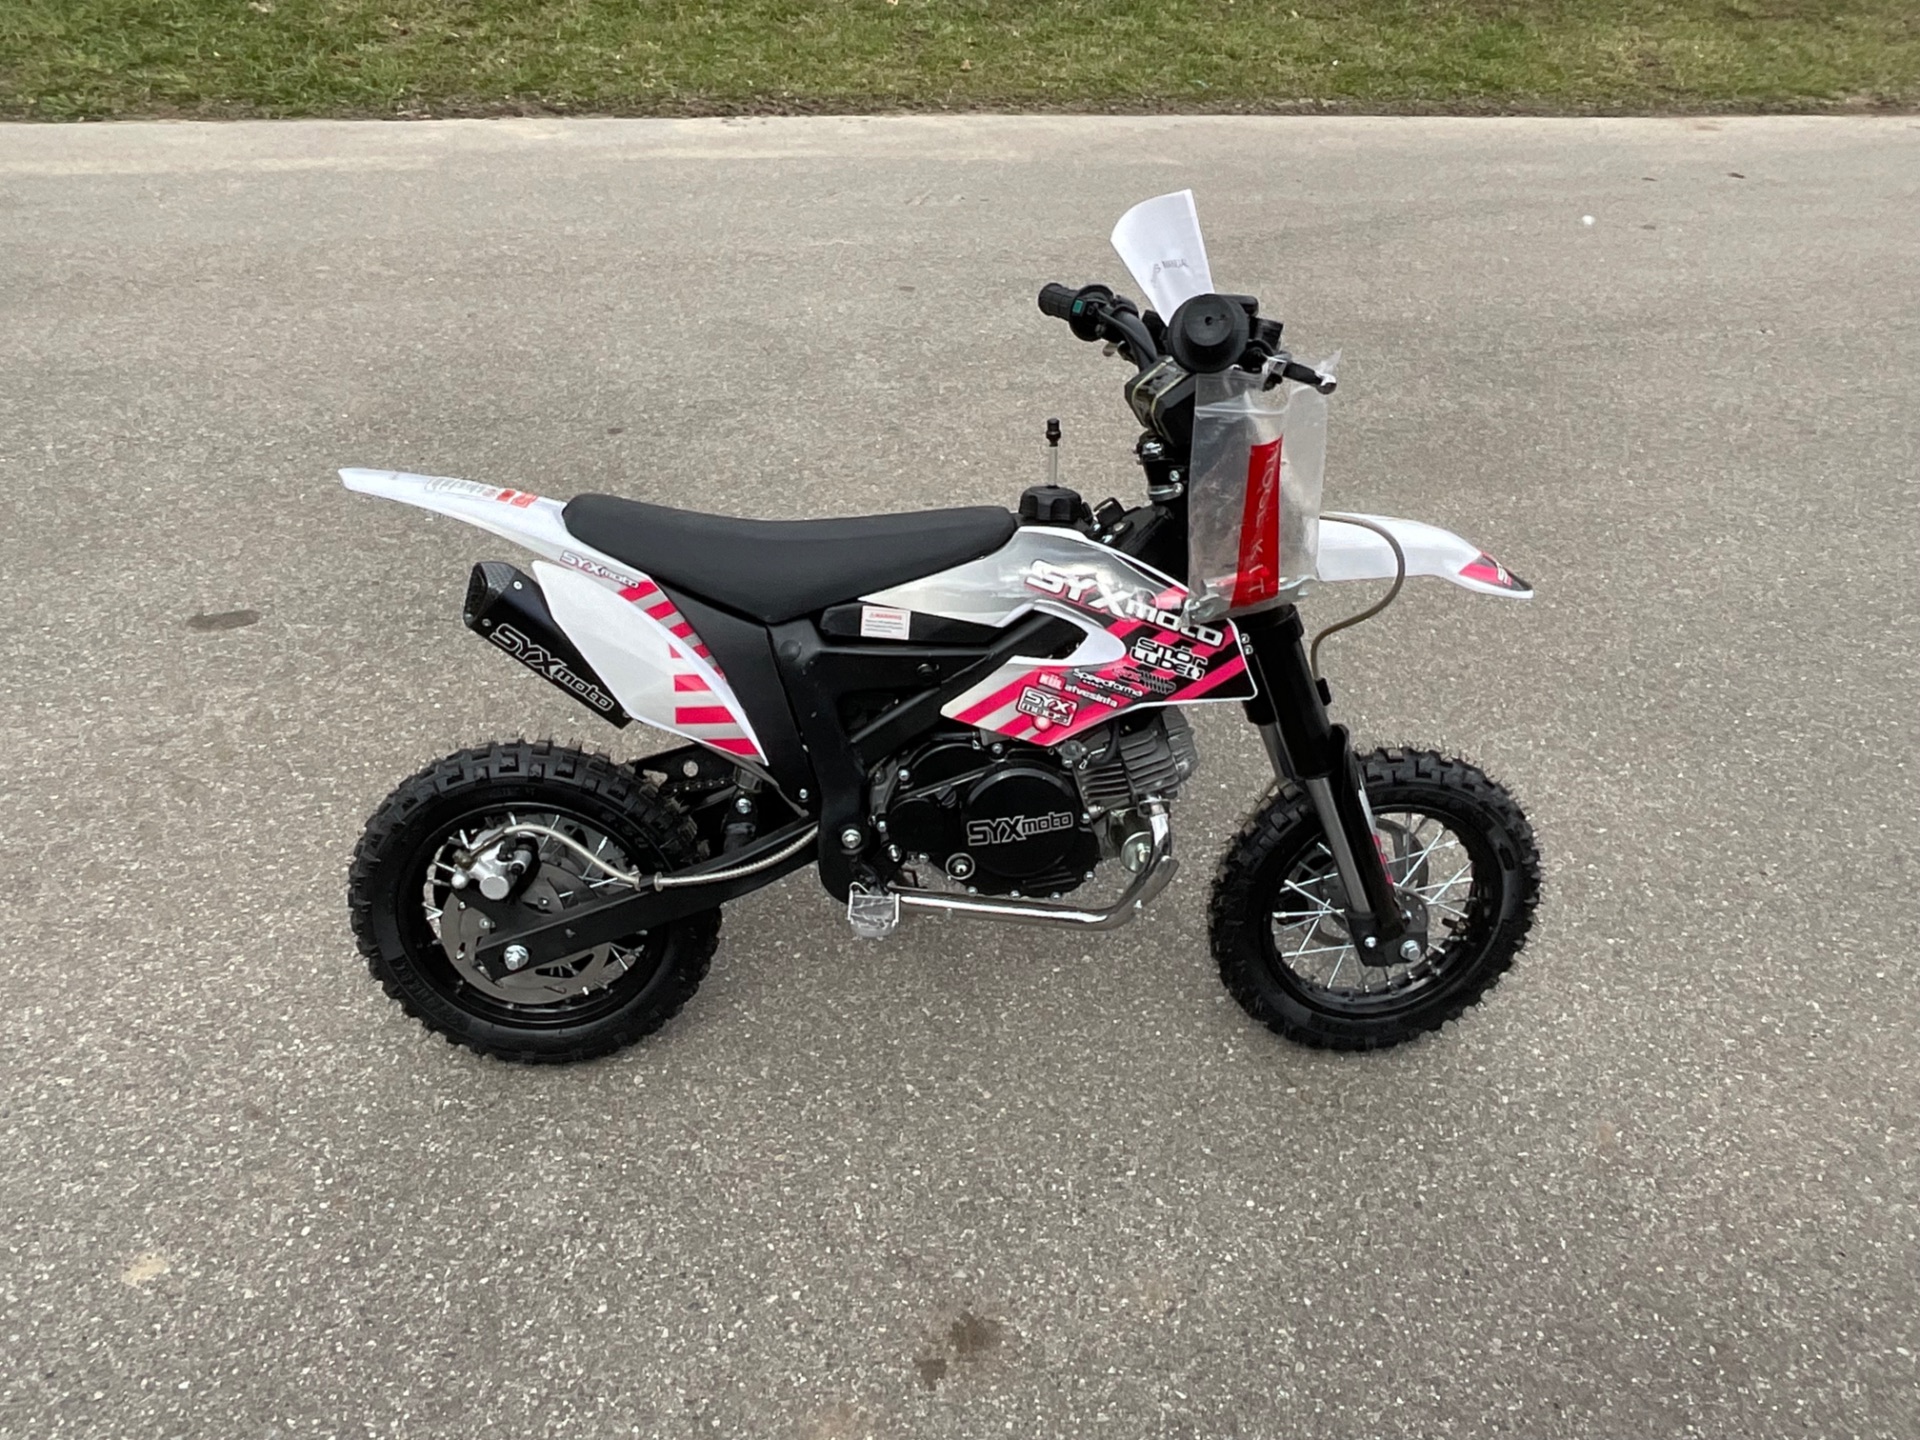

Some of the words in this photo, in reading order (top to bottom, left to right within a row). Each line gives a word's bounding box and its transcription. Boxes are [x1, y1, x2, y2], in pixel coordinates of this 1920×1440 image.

[1248, 539, 1264, 594] KIT
[489, 623, 614, 711] SYXmoto
[966, 811, 1074, 847] SYXmoto
